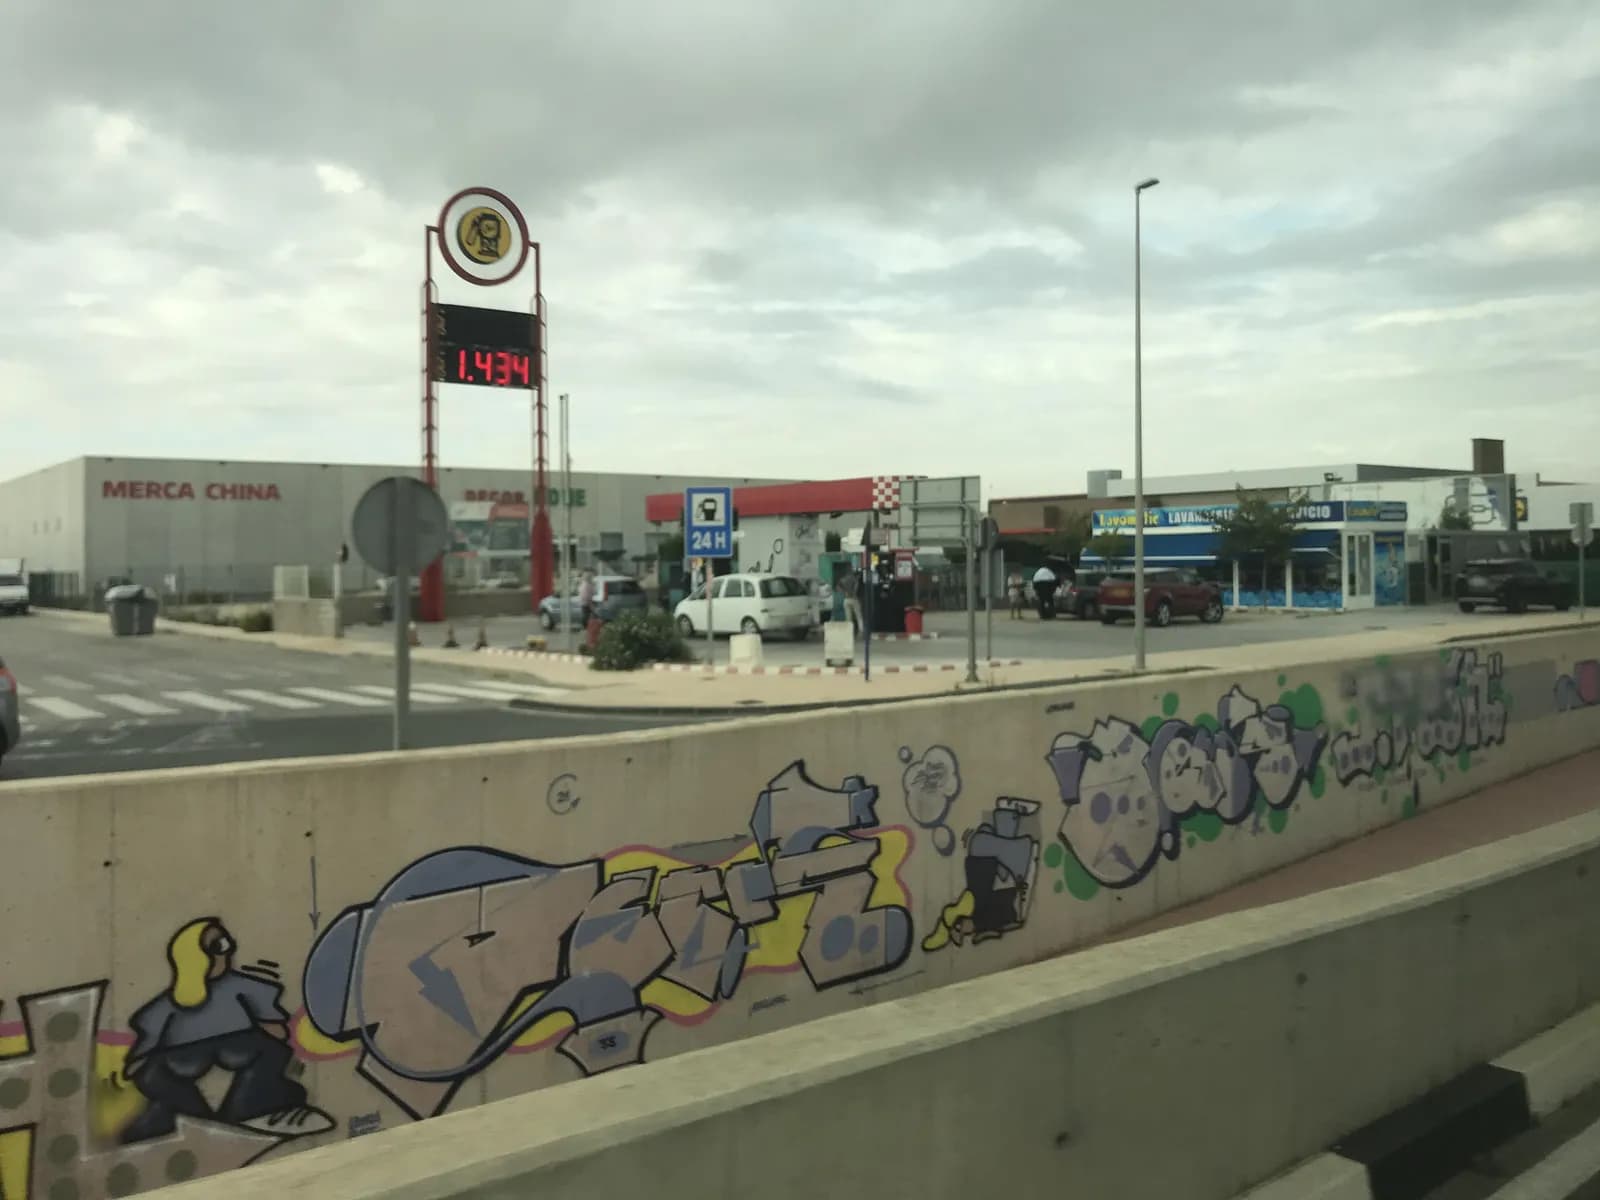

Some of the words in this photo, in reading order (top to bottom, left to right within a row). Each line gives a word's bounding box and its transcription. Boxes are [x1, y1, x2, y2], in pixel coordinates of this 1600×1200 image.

[458, 348, 530, 386] 1.434
[102, 480, 195, 499] MERCA
[205, 482, 281, 501] CHINA
[1099, 509, 1160, 527] Lavomtic
[691, 530, 712, 550] 24
[714, 530, 727, 550] H
